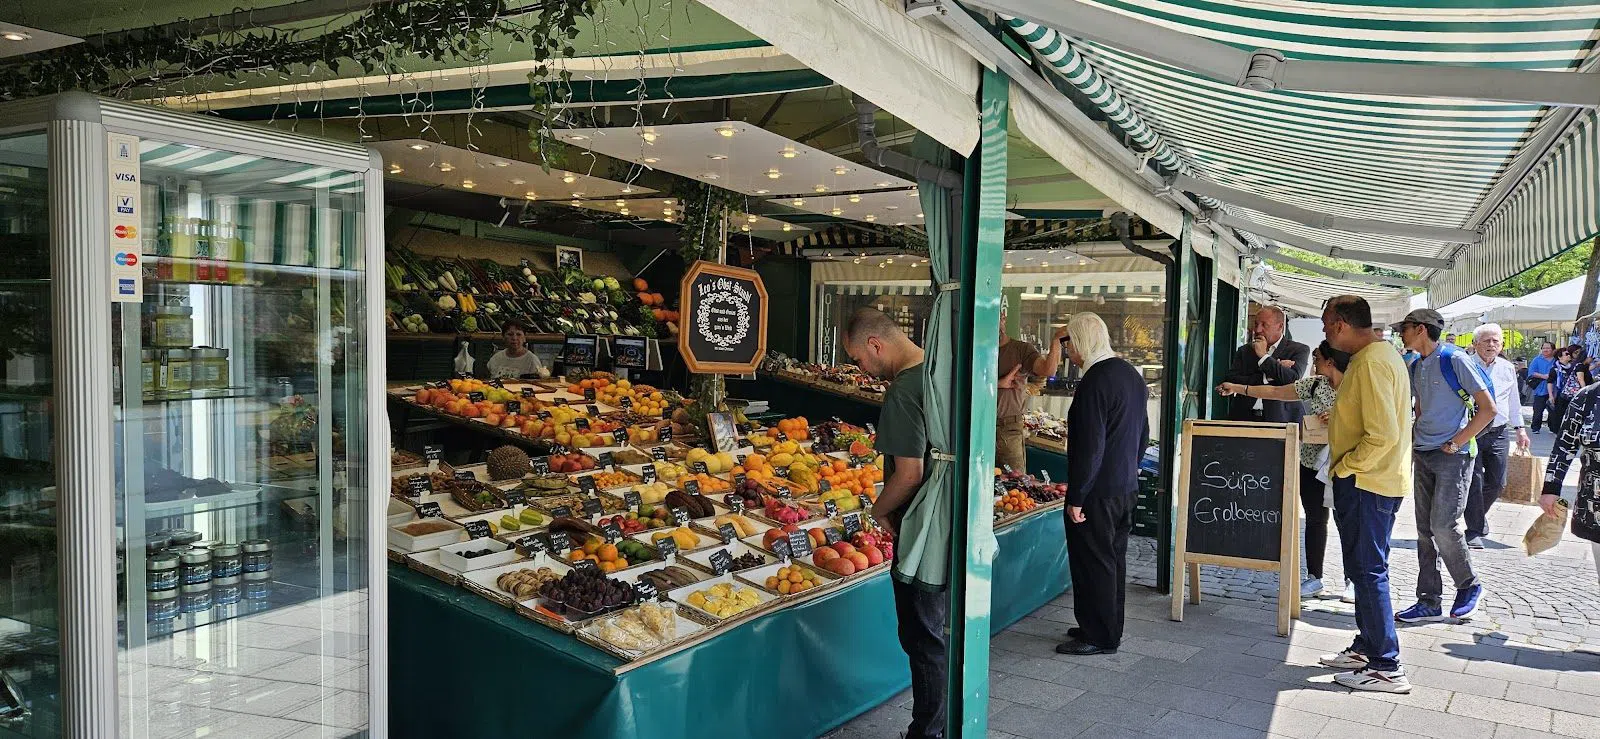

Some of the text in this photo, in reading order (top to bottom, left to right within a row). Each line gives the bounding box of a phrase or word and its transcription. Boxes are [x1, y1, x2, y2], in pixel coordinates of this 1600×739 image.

[114, 173, 136, 182] VISA
[122, 198, 129, 206] V
[1201, 461, 1271, 497] Süße
[1194, 497, 1281, 524] Erdbeeren
